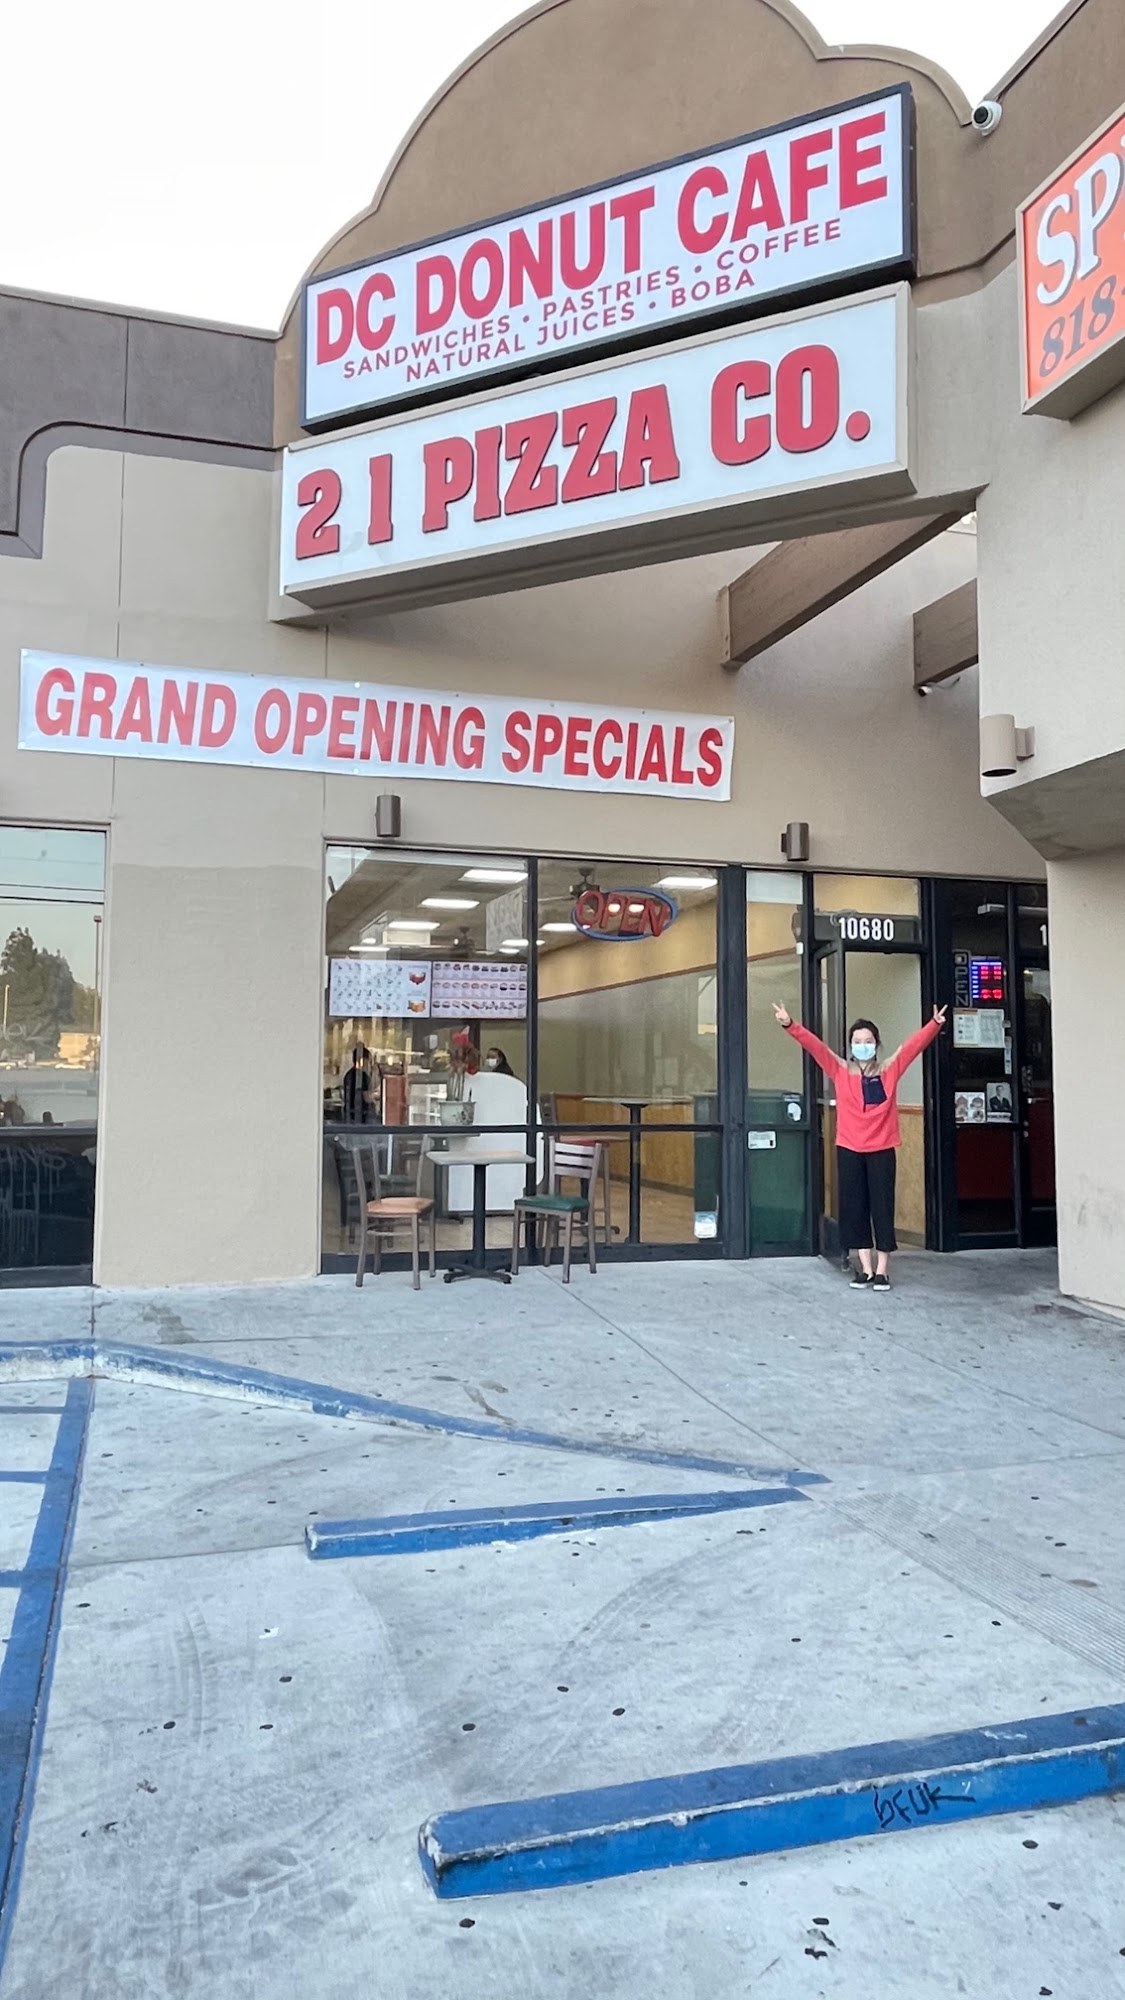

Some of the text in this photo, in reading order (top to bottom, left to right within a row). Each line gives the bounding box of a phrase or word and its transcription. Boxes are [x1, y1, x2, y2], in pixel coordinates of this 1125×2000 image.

[315, 111, 888, 365] DC DONUT CAFE
[1036, 134, 1125, 305] SP
[343, 219, 841, 379] SANDWICHES PASTRIES COFFEE
[406, 269, 754, 382] NATURAL JUICES BOBA
[423, 384, 679, 532] PIZZA
[711, 344, 871, 466] CO.
[35, 668, 724, 788] GRAND OPENING SPECIALS
[576, 890, 669, 937] OPEN
[839, 917, 894, 941] 10680
